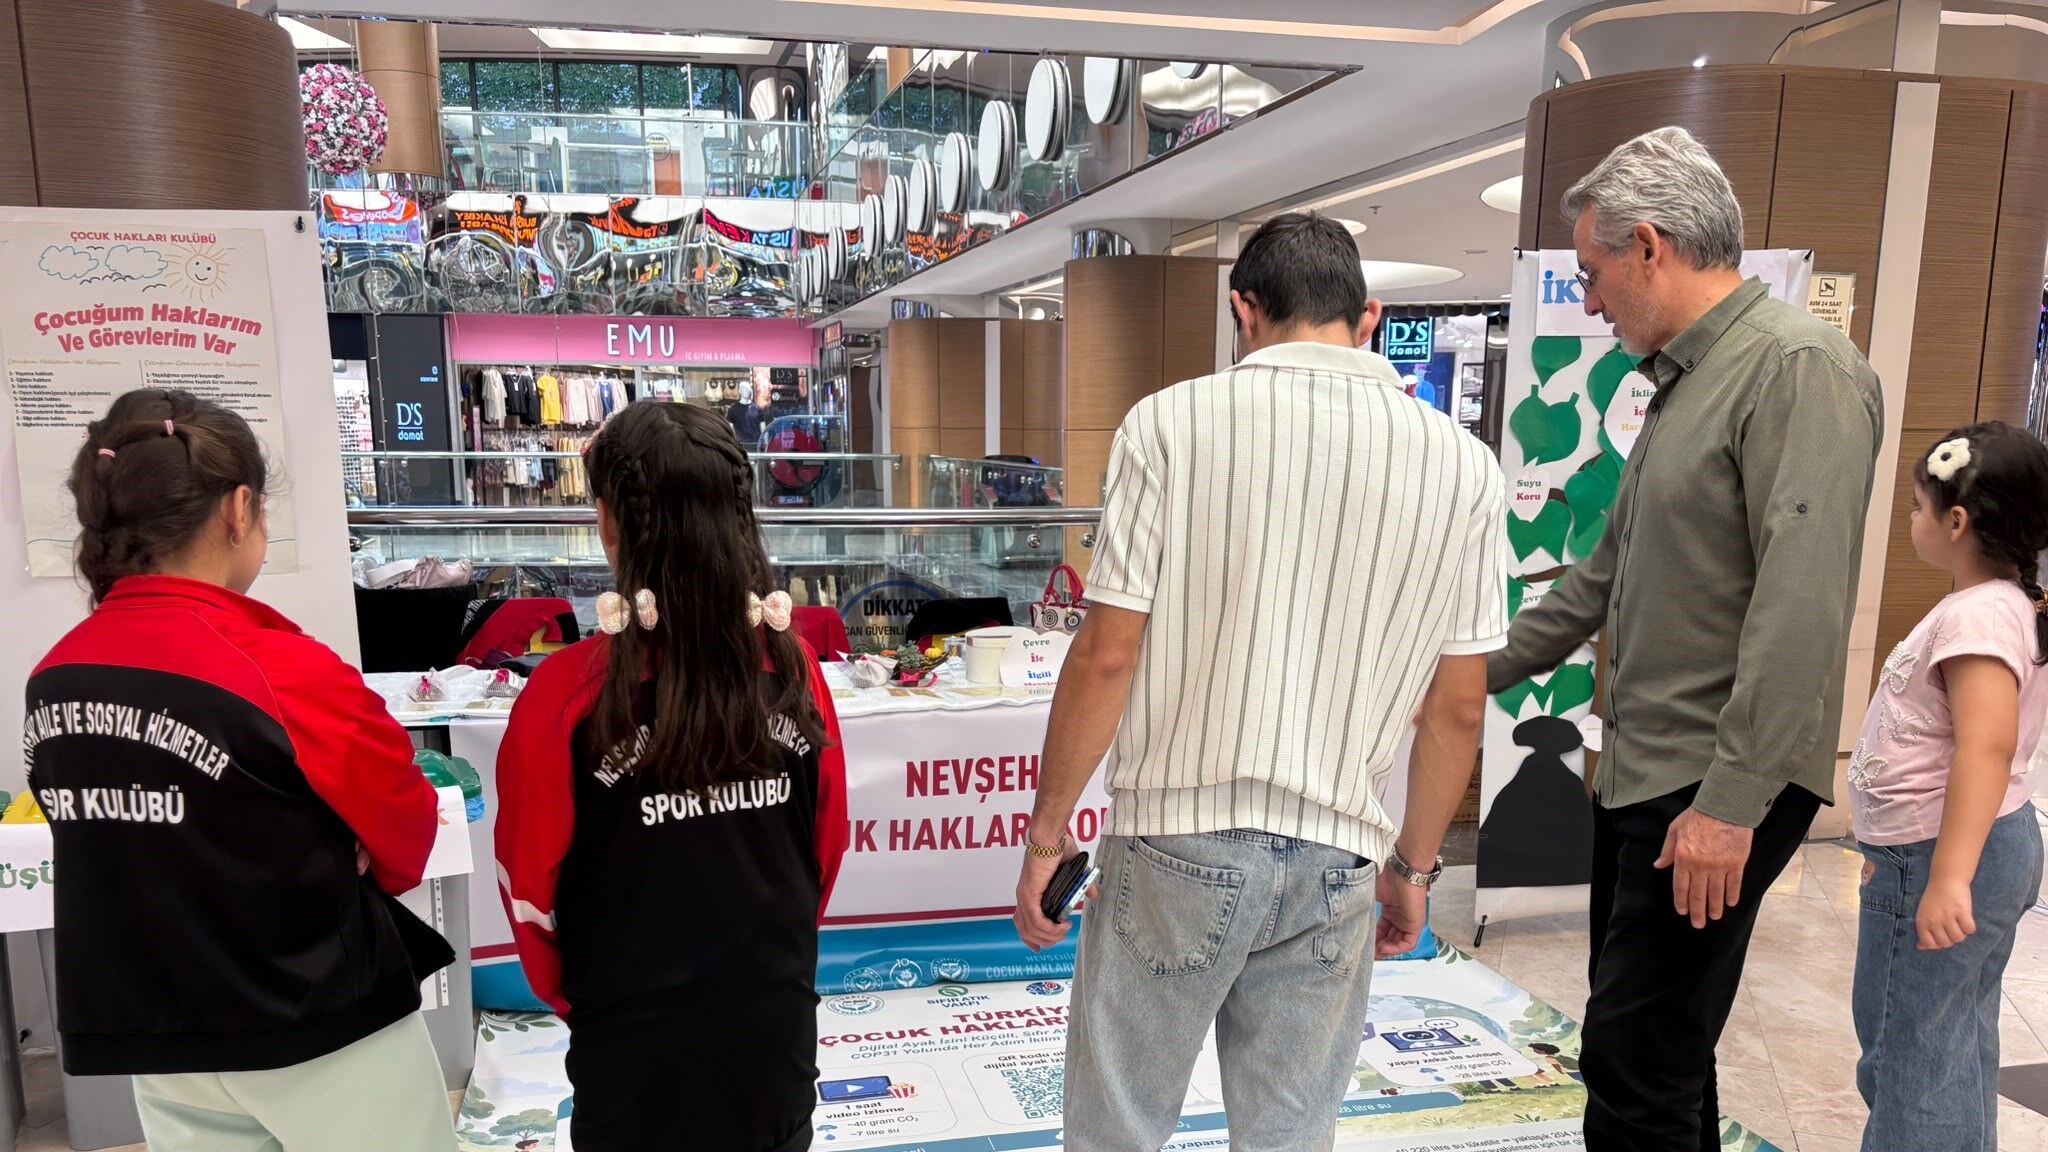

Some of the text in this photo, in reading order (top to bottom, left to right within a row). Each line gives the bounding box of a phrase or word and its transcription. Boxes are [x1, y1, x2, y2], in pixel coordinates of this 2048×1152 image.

[70, 231, 217, 244] ÇOCUK HAKLARI KULÜBÜ
[1542, 270, 1585, 304] İK
[34, 303, 262, 336] Çocuğum Haklarım
[607, 323, 675, 357] EMU
[1390, 321, 1428, 342] D'S
[58, 326, 237, 355] Ve Görevlerim Var
[1389, 346, 1427, 355] damat
[396, 403, 423, 426] D'S
[398, 430, 424, 440] damat
[1516, 479, 1541, 488] Suyu
[1516, 492, 1541, 501] Koru
[1023, 639, 1050, 649] Çevre
[1027, 670, 1052, 679] İlgili
[34, 699, 230, 781] AİLE VE SOSYAL HİZMETLER
[906, 755, 1039, 804] NEVŞEH
[81, 783, 185, 824] KULÜBÜ
[640, 772, 792, 826] SPOR KULÜBÜ
[889, 812, 1031, 852] HAKLAR
[952, 1006, 1069, 1023] TÜRKİY
[819, 1027, 931, 1047] ÇOCUK
[859, 1043, 898, 1052] Dijital
[902, 1039, 936, 1048] Ayak
[1022, 1028, 1049, 1037] Sıfır
[851, 1050, 898, 1060] COP31
[903, 1045, 959, 1054] Yolunda
[990, 1038, 1025, 1047] Adım
[998, 1054, 1017, 1062] QR
[1019, 1052, 1050, 1060] kodu
[983, 1061, 1017, 1070] dijital
[1020, 1058, 1047, 1066] ayak
[825, 1106, 905, 1119] video izleme
[855, 1101, 882, 1109] saat
[1354, 1101, 1375, 1112] litre
[1377, 1102, 1391, 1110] su
[869, 1117, 895, 1127] gram
[1178, 1138, 1232, 1150] yaparsa
